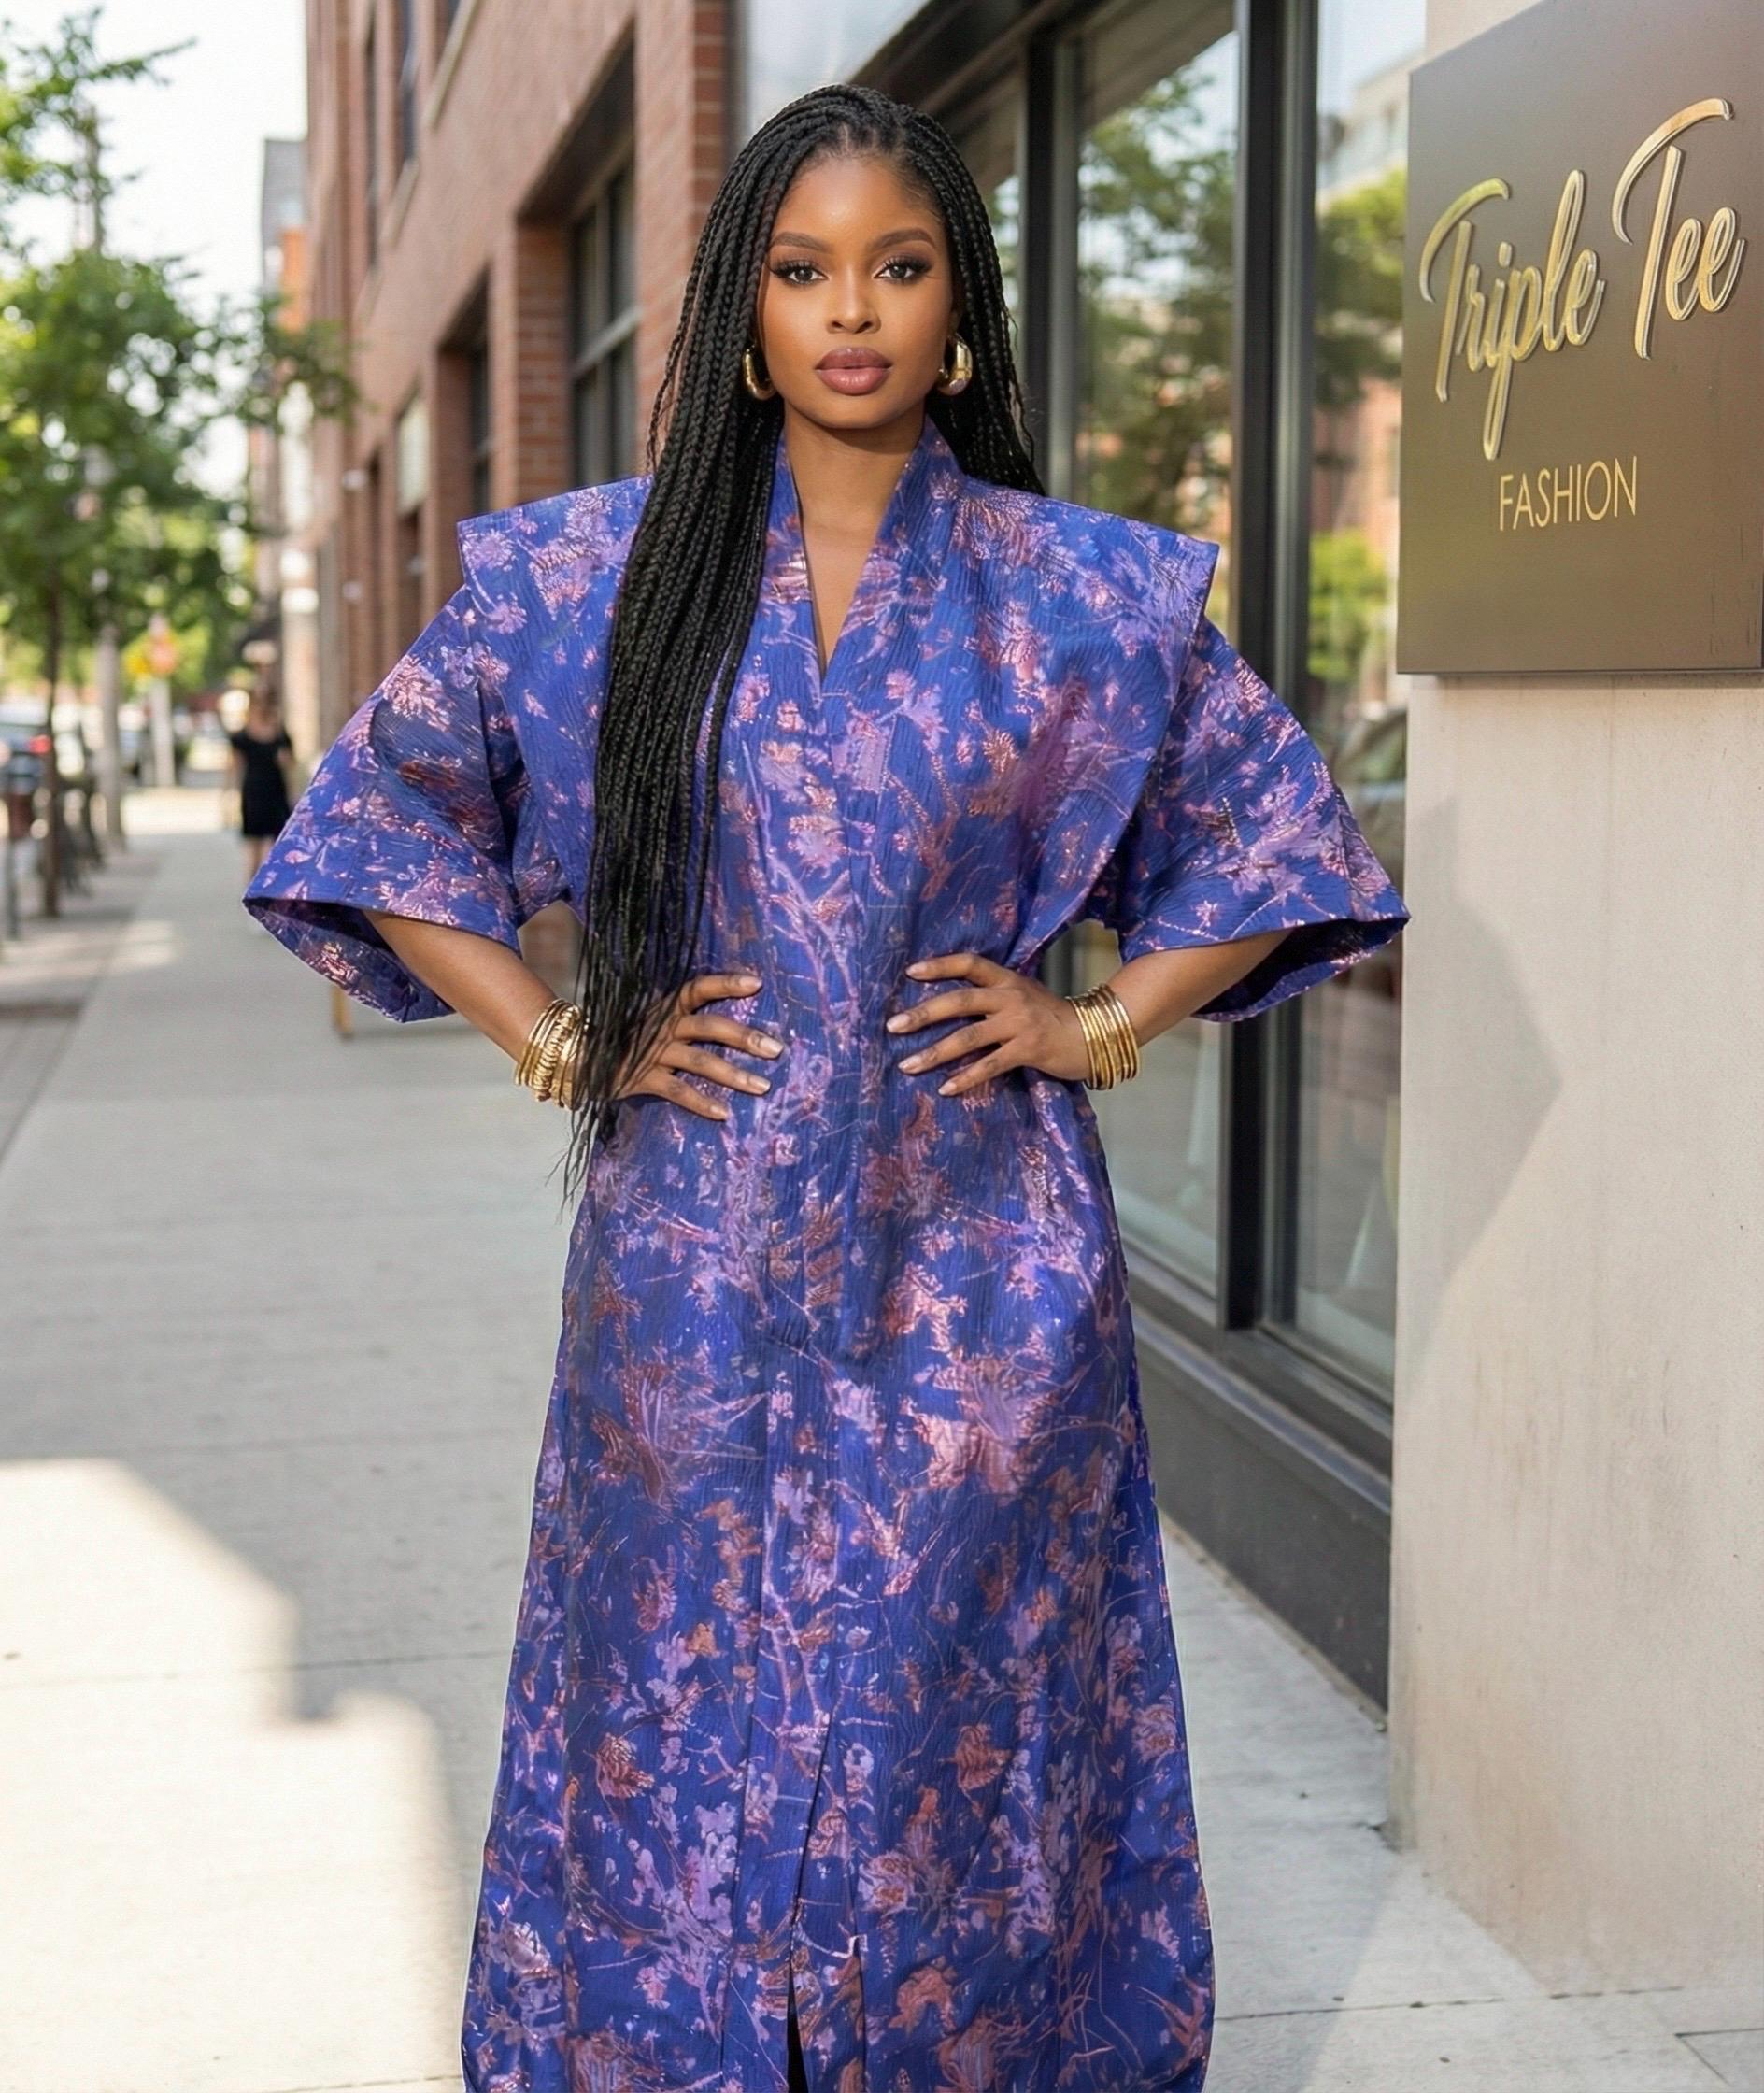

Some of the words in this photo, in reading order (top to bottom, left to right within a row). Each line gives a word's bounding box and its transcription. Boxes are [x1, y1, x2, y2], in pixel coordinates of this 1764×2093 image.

[1419, 169, 1605, 461] Triple
[1612, 97, 1745, 361] Tee
[1499, 456, 1638, 532] FASHION
